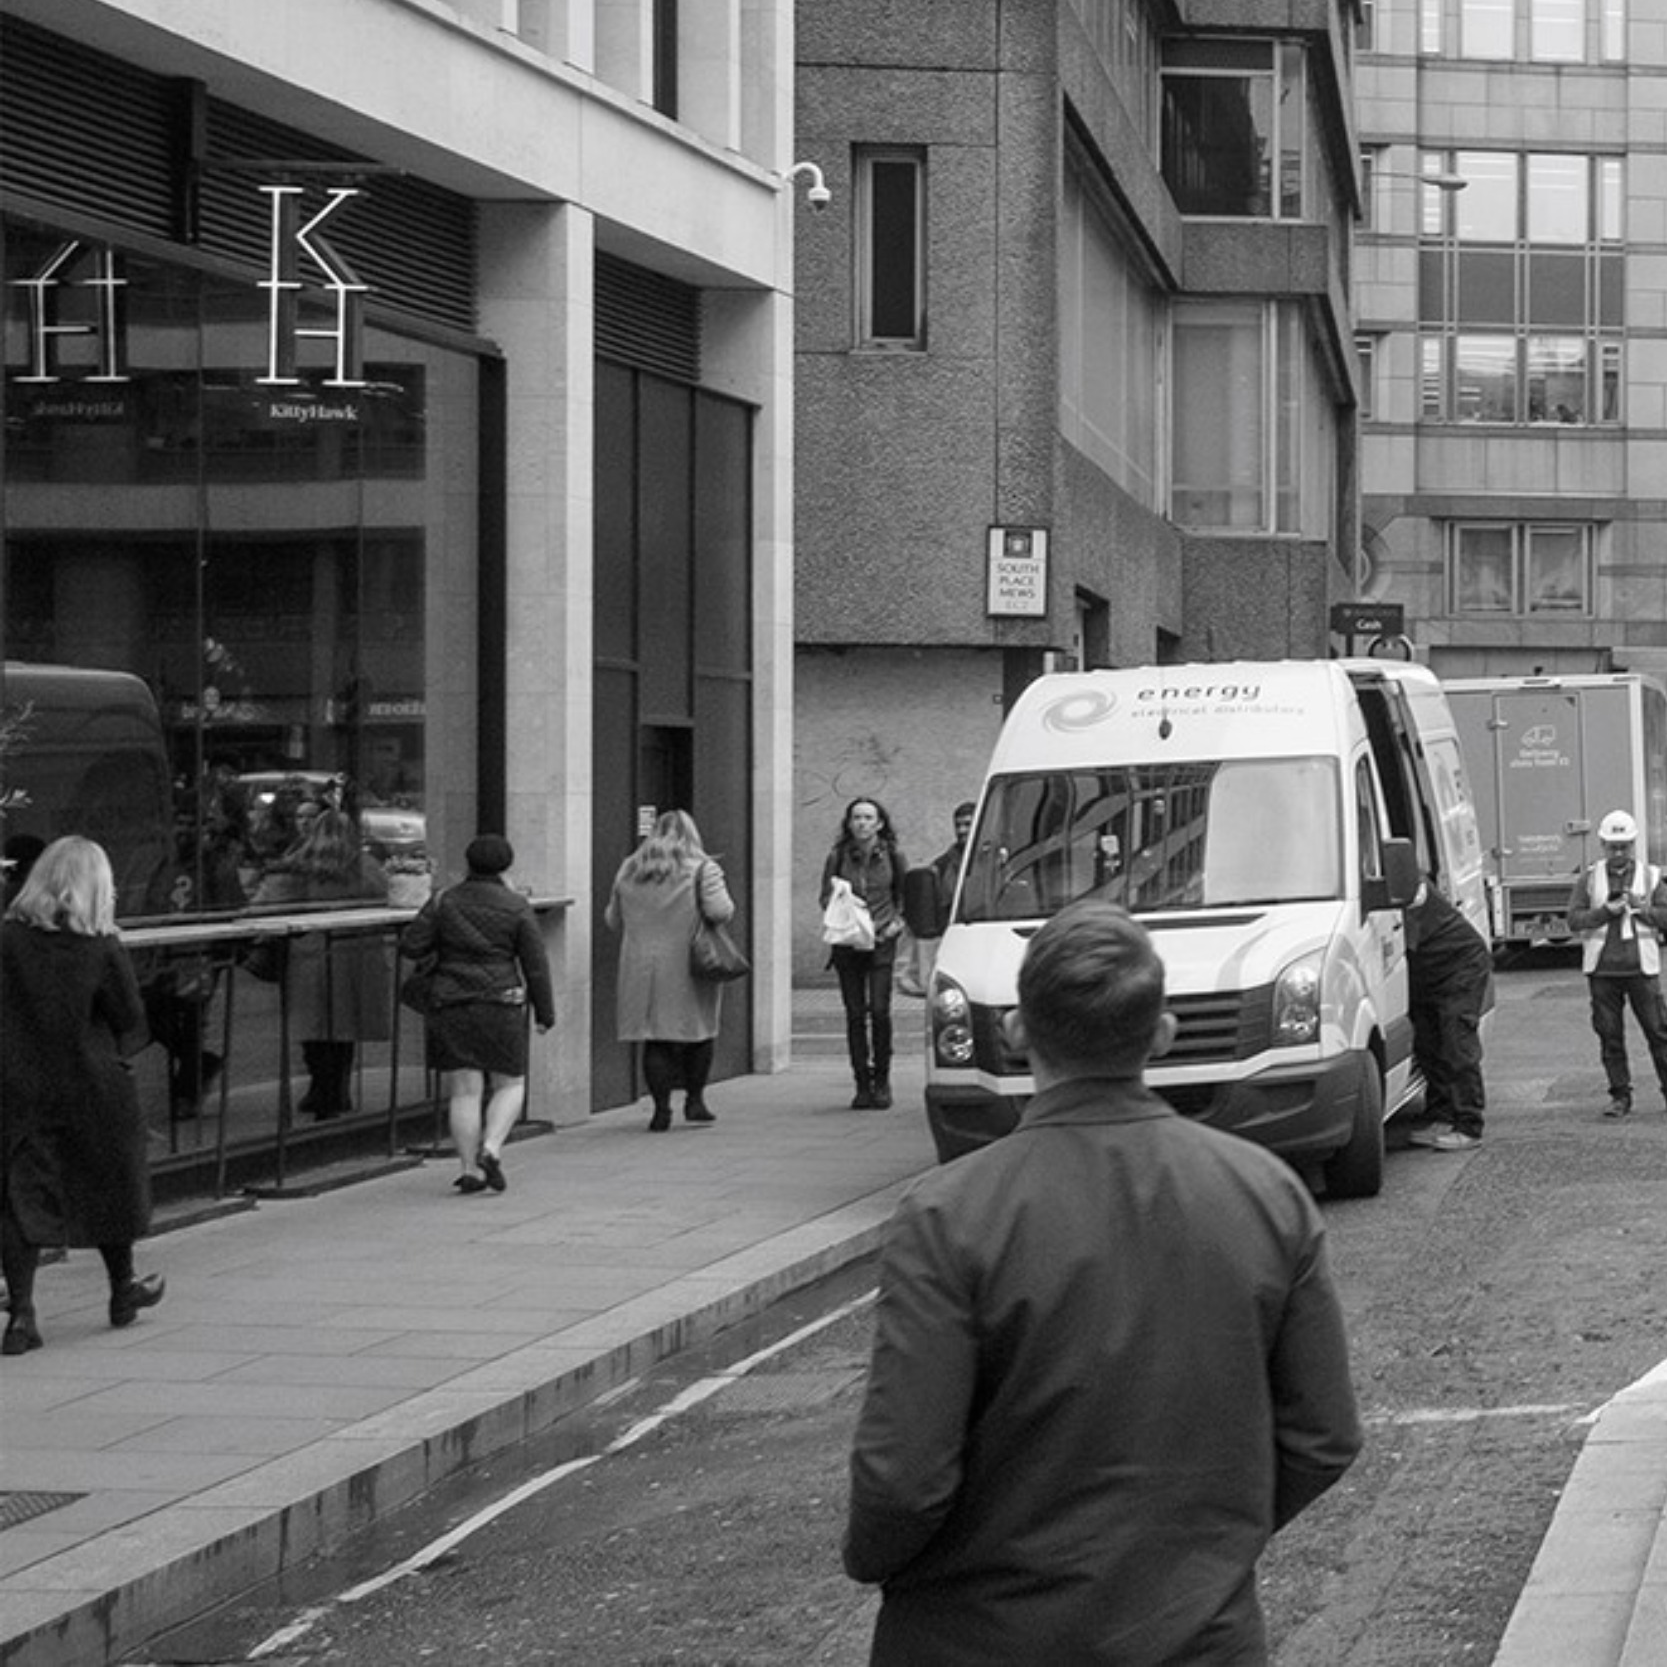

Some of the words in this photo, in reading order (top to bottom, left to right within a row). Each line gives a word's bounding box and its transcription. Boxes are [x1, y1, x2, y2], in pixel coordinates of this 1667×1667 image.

[269, 402, 358, 423] KittyHawk
[997, 562, 1040, 574] SOUTH
[998, 575, 1035, 586] PLACE
[998, 587, 1036, 599] MEWS
[1137, 685, 1261, 702] energy
